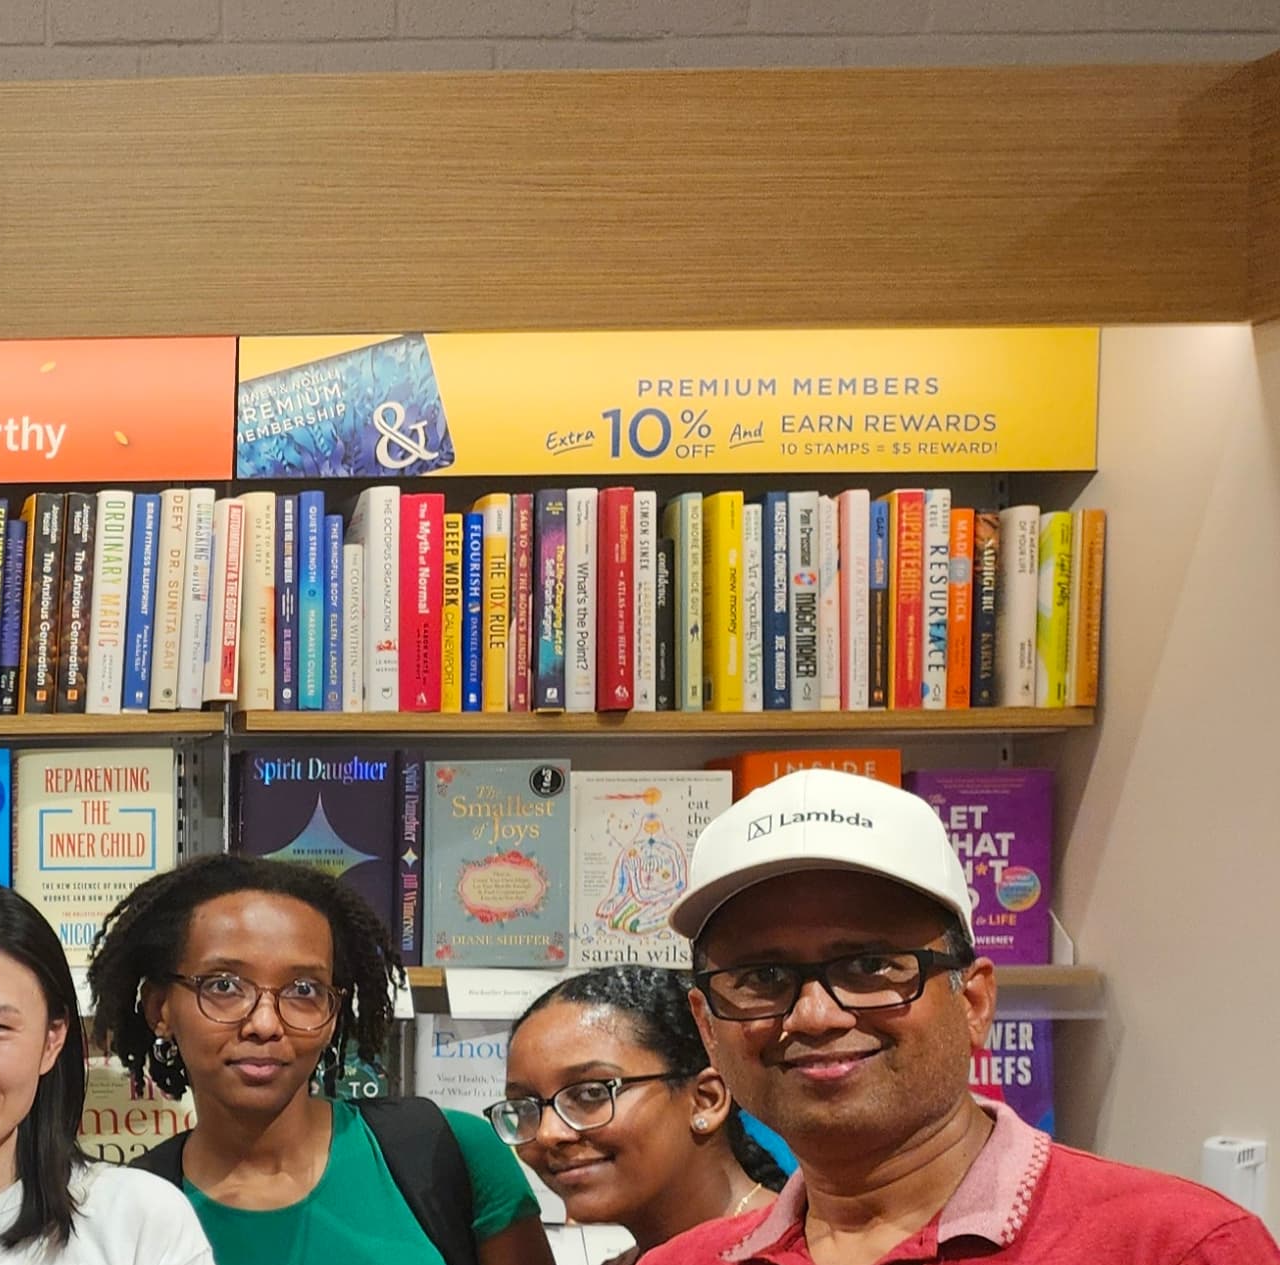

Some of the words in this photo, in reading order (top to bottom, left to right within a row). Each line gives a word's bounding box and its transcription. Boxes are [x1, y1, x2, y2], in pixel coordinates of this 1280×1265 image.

[637, 378, 777, 397] PREMIUM
[793, 376, 940, 396] MEMBERS
[545, 428, 595, 450] Extra
[729, 421, 764, 442] And
[781, 414, 853, 433] EARN
[864, 413, 997, 432] REWARDS
[675, 443, 716, 460] OFF
[780, 443, 798, 455] 10
[804, 442, 870, 455] STAMPS
[891, 441, 911, 455] $5
[918, 441, 999, 454] REWARD!
[45, 768, 150, 793] REPARENTING
[253, 757, 303, 785] Spirit
[308, 756, 387, 785] Daughter
[81, 800, 111, 825] THE
[451, 795, 555, 817] Smallest
[471, 822, 486, 838] of
[487, 816, 540, 844] Joys
[779, 809, 873, 829] Lambda
[49, 833, 96, 859] INNER
[100, 832, 145, 857] CHILD
